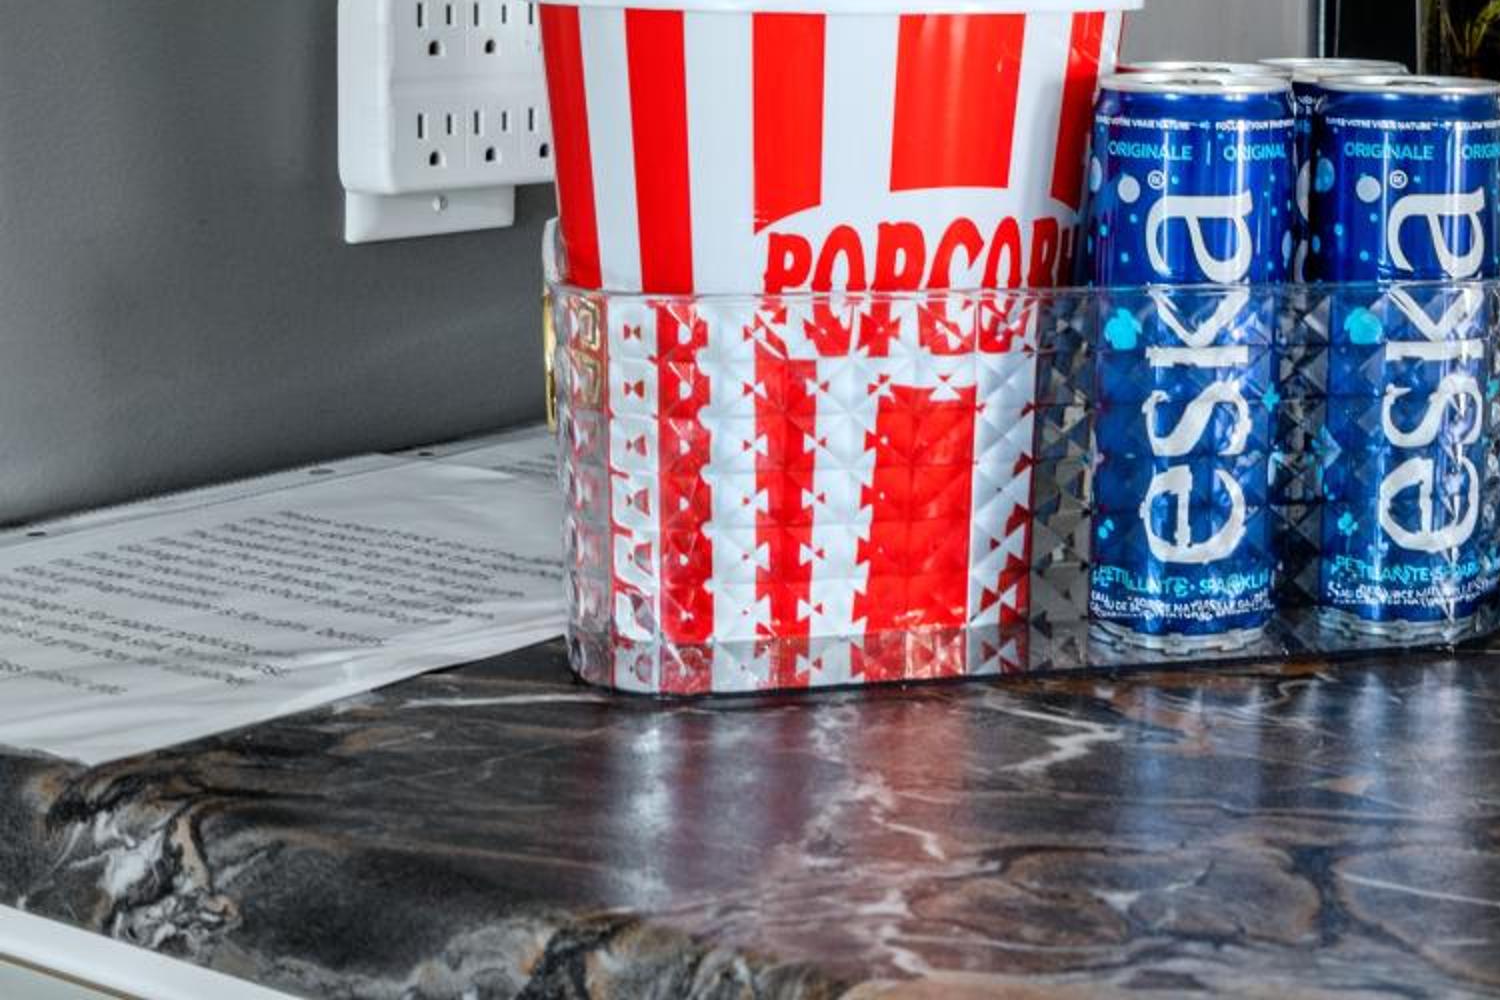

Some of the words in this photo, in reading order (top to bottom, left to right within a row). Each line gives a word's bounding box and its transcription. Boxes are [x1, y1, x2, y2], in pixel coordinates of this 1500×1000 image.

[1108, 140, 1193, 161] ORIGINALE
[1223, 142, 1287, 161] ORIGINAL
[1343, 141, 1435, 161] ORIGINALE
[1141, 190, 1253, 563] eska
[1379, 187, 1484, 552] eska
